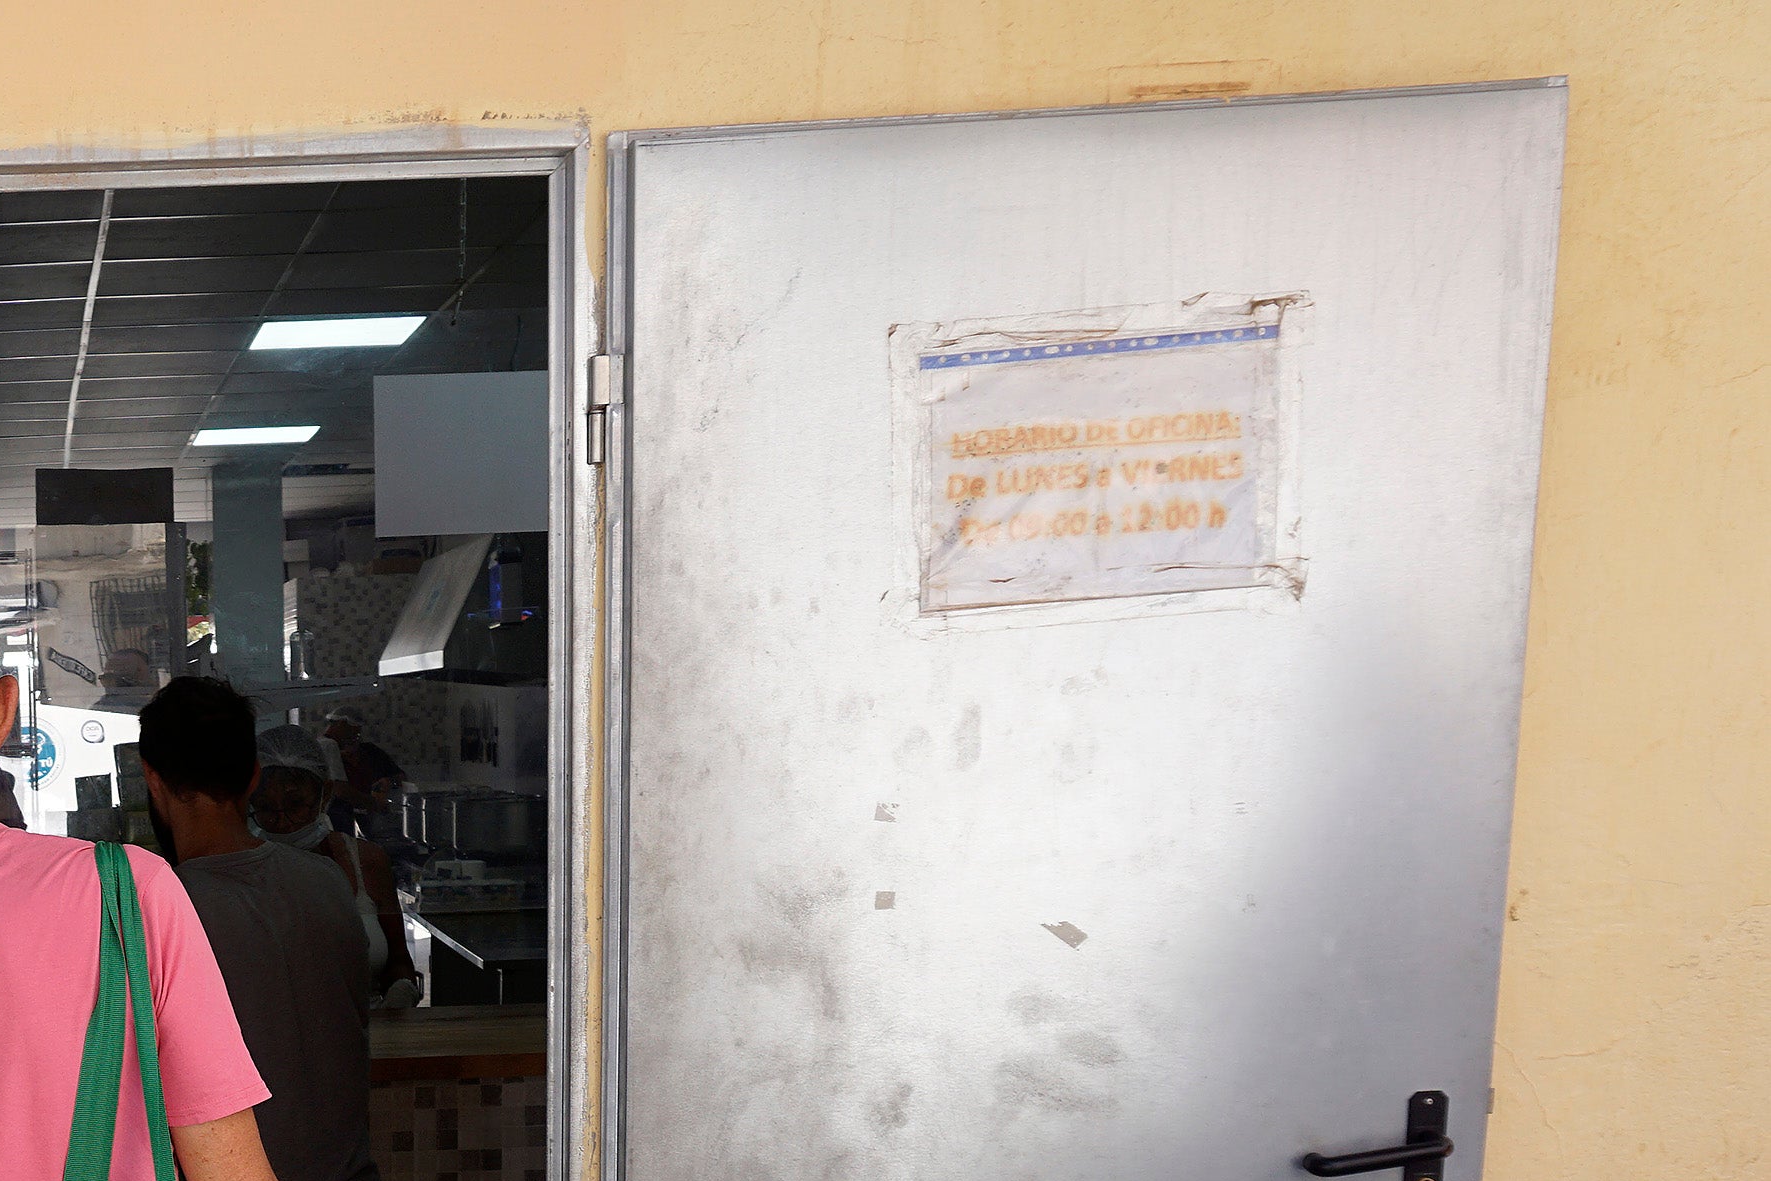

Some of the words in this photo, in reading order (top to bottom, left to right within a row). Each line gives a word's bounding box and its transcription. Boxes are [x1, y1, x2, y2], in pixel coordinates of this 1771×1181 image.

[946, 473, 988, 501] De
[994, 462, 1089, 495] LUNES
[1208, 498, 1227, 529] h
